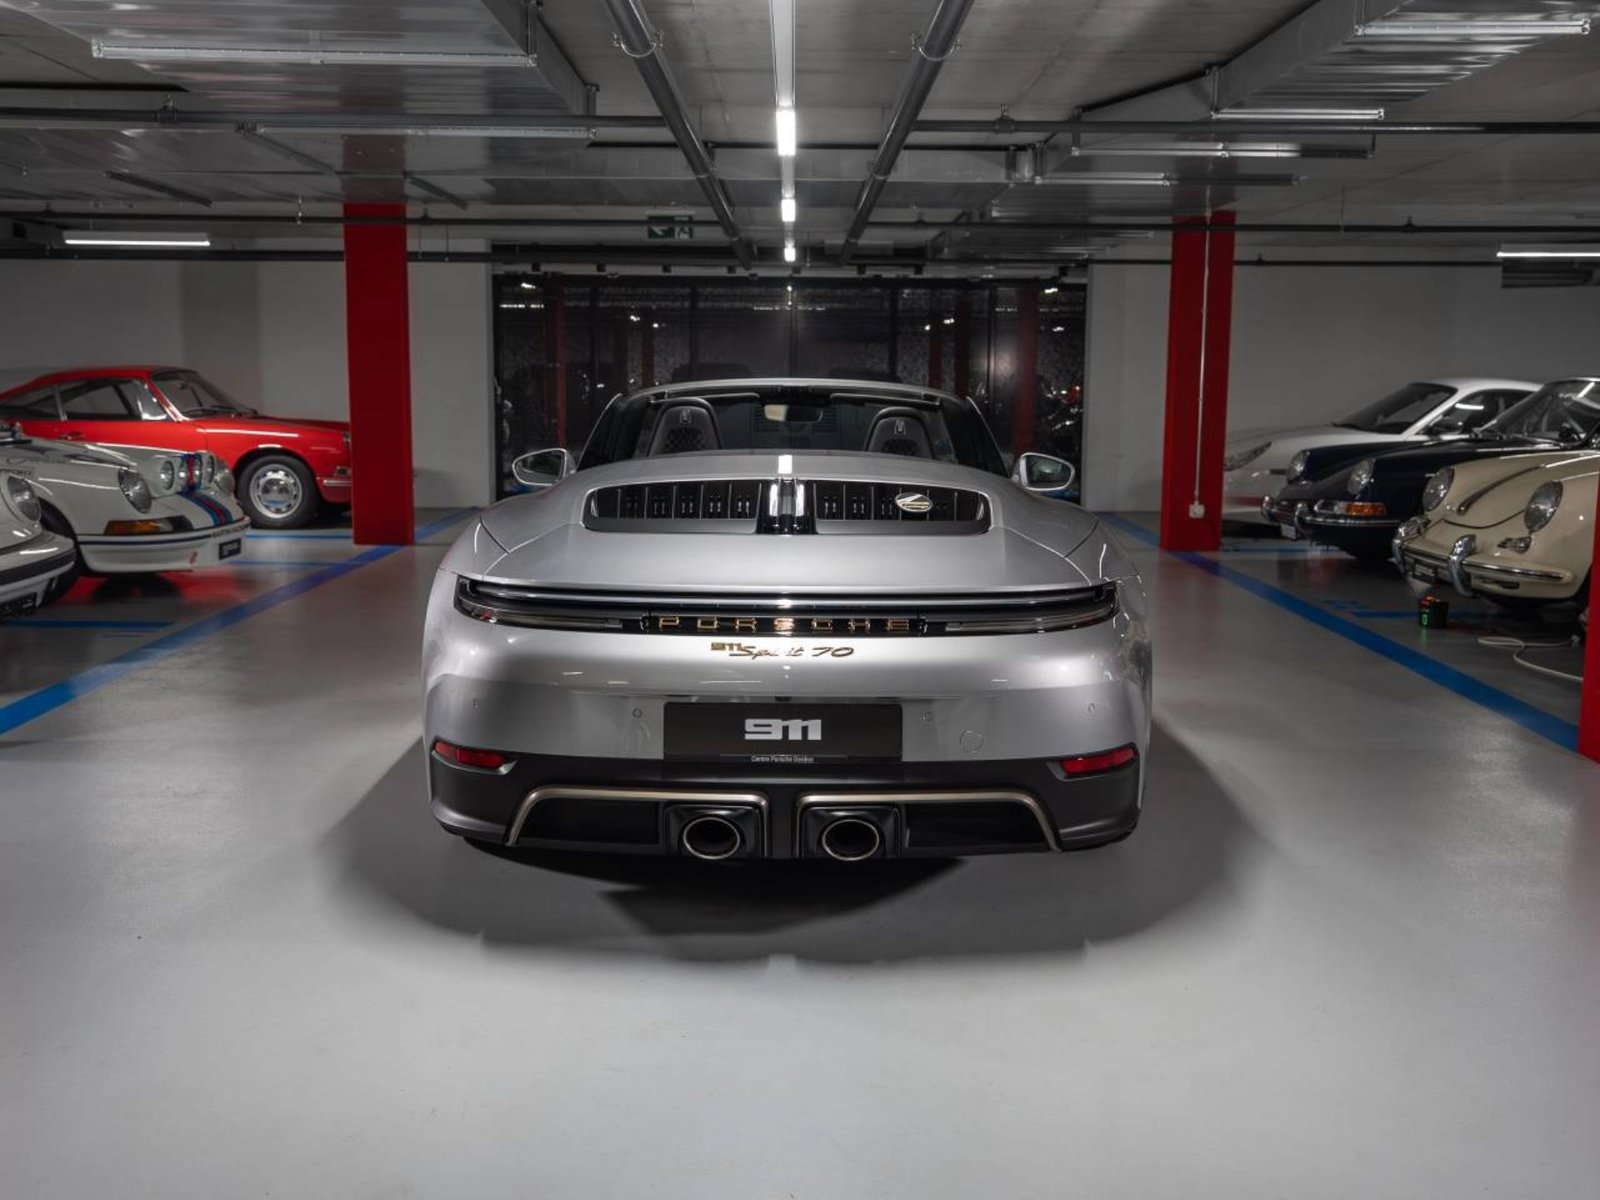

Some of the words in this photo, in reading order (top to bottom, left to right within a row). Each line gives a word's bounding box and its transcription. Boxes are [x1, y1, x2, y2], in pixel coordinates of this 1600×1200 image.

[659, 616, 910, 632] PORSCHE
[711, 642, 742, 652] 911
[729, 645, 805, 660] Spiit
[811, 646, 855, 658] 70
[745, 718, 822, 740] 911
